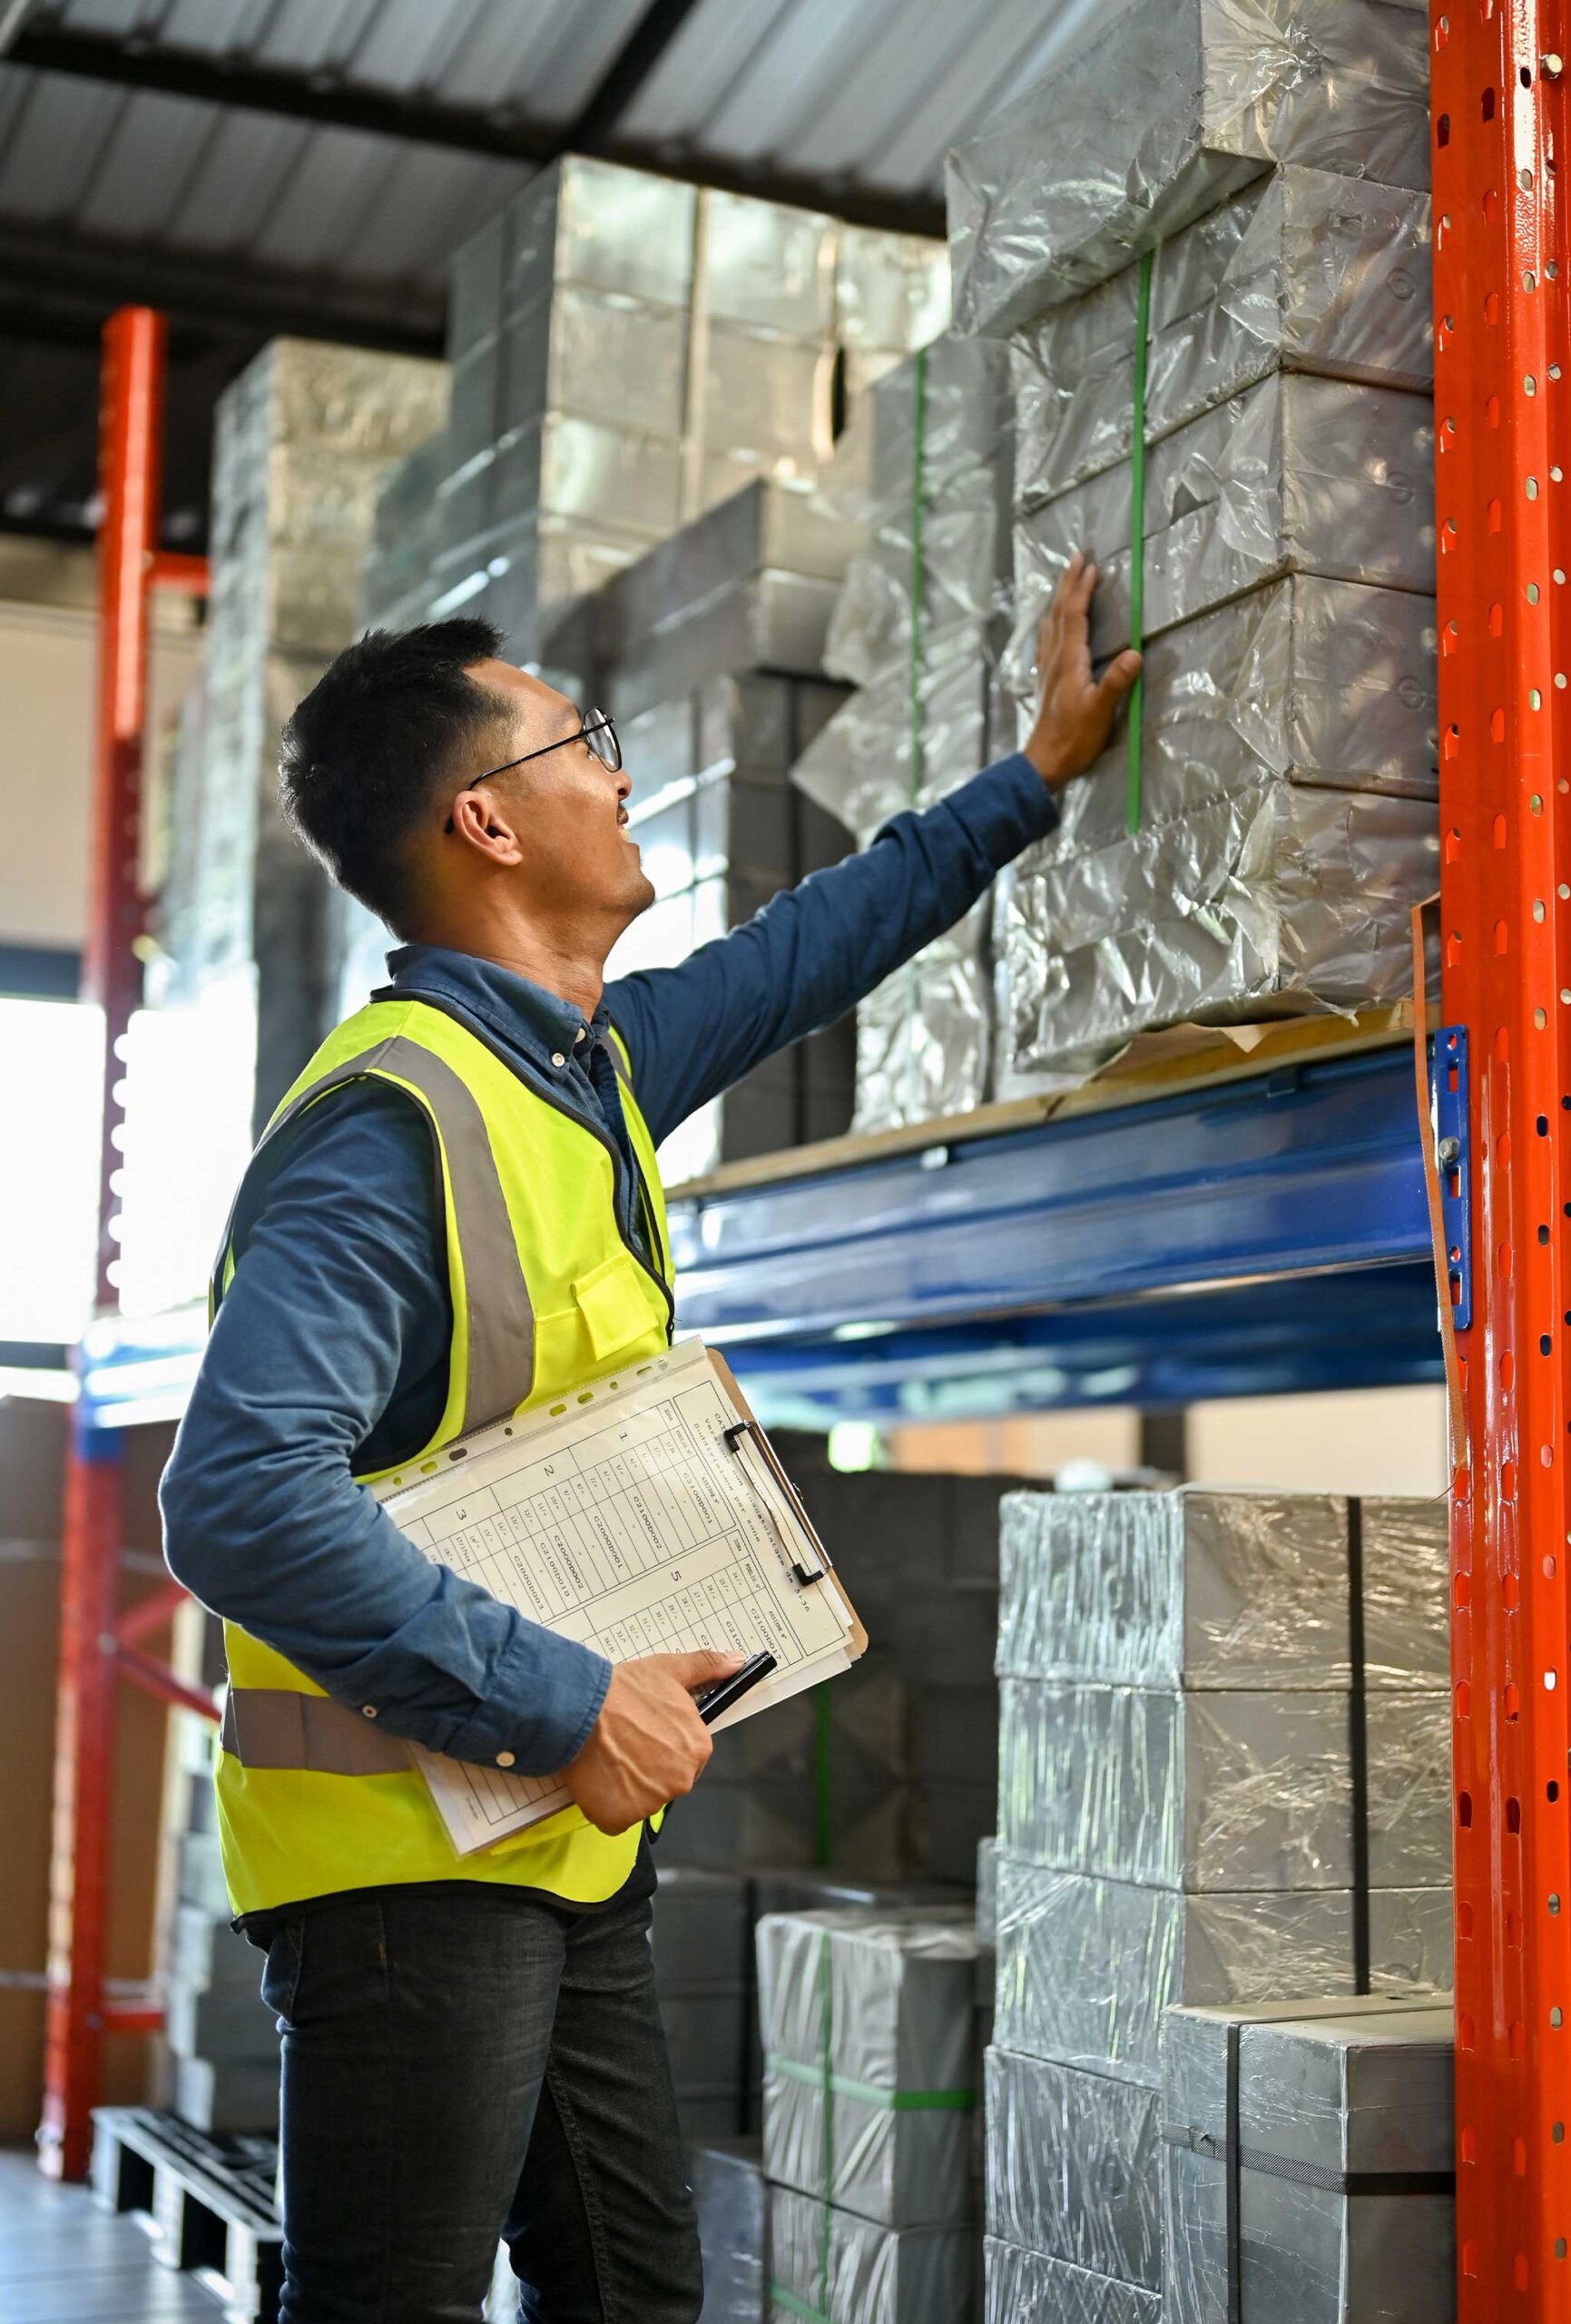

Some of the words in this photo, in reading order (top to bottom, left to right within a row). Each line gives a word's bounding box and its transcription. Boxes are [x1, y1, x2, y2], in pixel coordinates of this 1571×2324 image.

[618, 1432, 628, 1441] 1
[663, 1408, 673, 1421] ZONA
[713, 1413, 728, 1433] CAT
[544, 1464, 555, 1476] 2
[693, 1423, 733, 1491] Suddivisione
[733, 1496, 746, 1512] per
[746, 1519, 761, 1542] zone
[456, 1508, 466, 1520] 3
[632, 1496, 663, 1549] C2100D002
[682, 1472, 712, 1523] C2100D001
[704, 1418, 731, 1463] Versione
[731, 1469, 743, 1486] con
[785, 1571, 793, 1582] da
[553, 1535, 584, 1589] C2000D002
[593, 1515, 623, 1568] C2000D001
[732, 1539, 741, 1551] ZONA
[513, 1555, 545, 1609] C2000D003
[538, 1542, 570, 1597] C2100D010
[671, 1570, 682, 1581] 5
[750, 1608, 781, 1659] C2100D017
